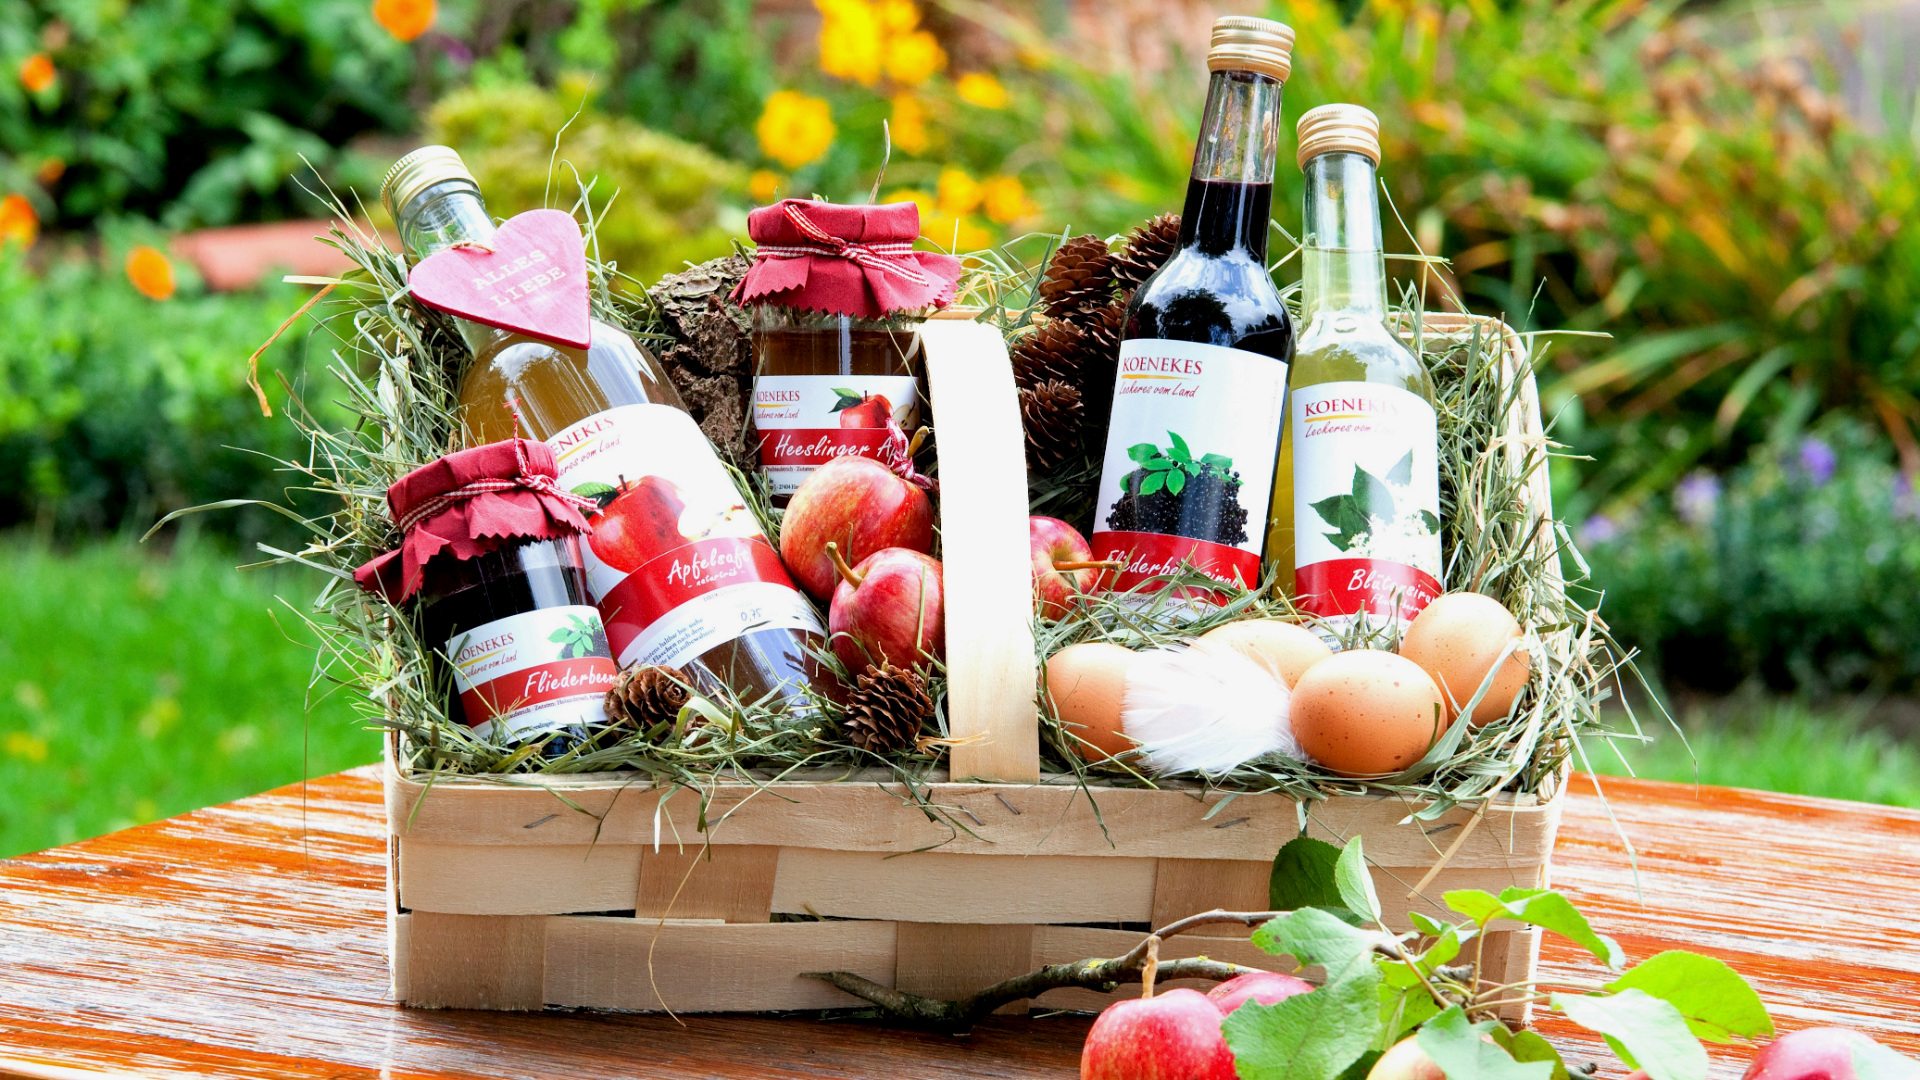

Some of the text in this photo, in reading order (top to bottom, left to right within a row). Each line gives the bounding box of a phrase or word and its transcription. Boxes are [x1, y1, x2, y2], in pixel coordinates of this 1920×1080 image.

[472, 249, 547, 291] ALLES
[489, 266, 567, 308] LIEBE
[1122, 356, 1203, 375] KOENEKES
[1153, 384, 1172, 395] vom
[1171, 382, 1200, 398] Land
[1305, 420, 1353, 438] Leckeres
[1353, 423, 1372, 432] vom
[667, 545, 750, 586] Apfelsaft
[740, 608, 763, 622] 0,75
[500, 649, 518, 665] Land
